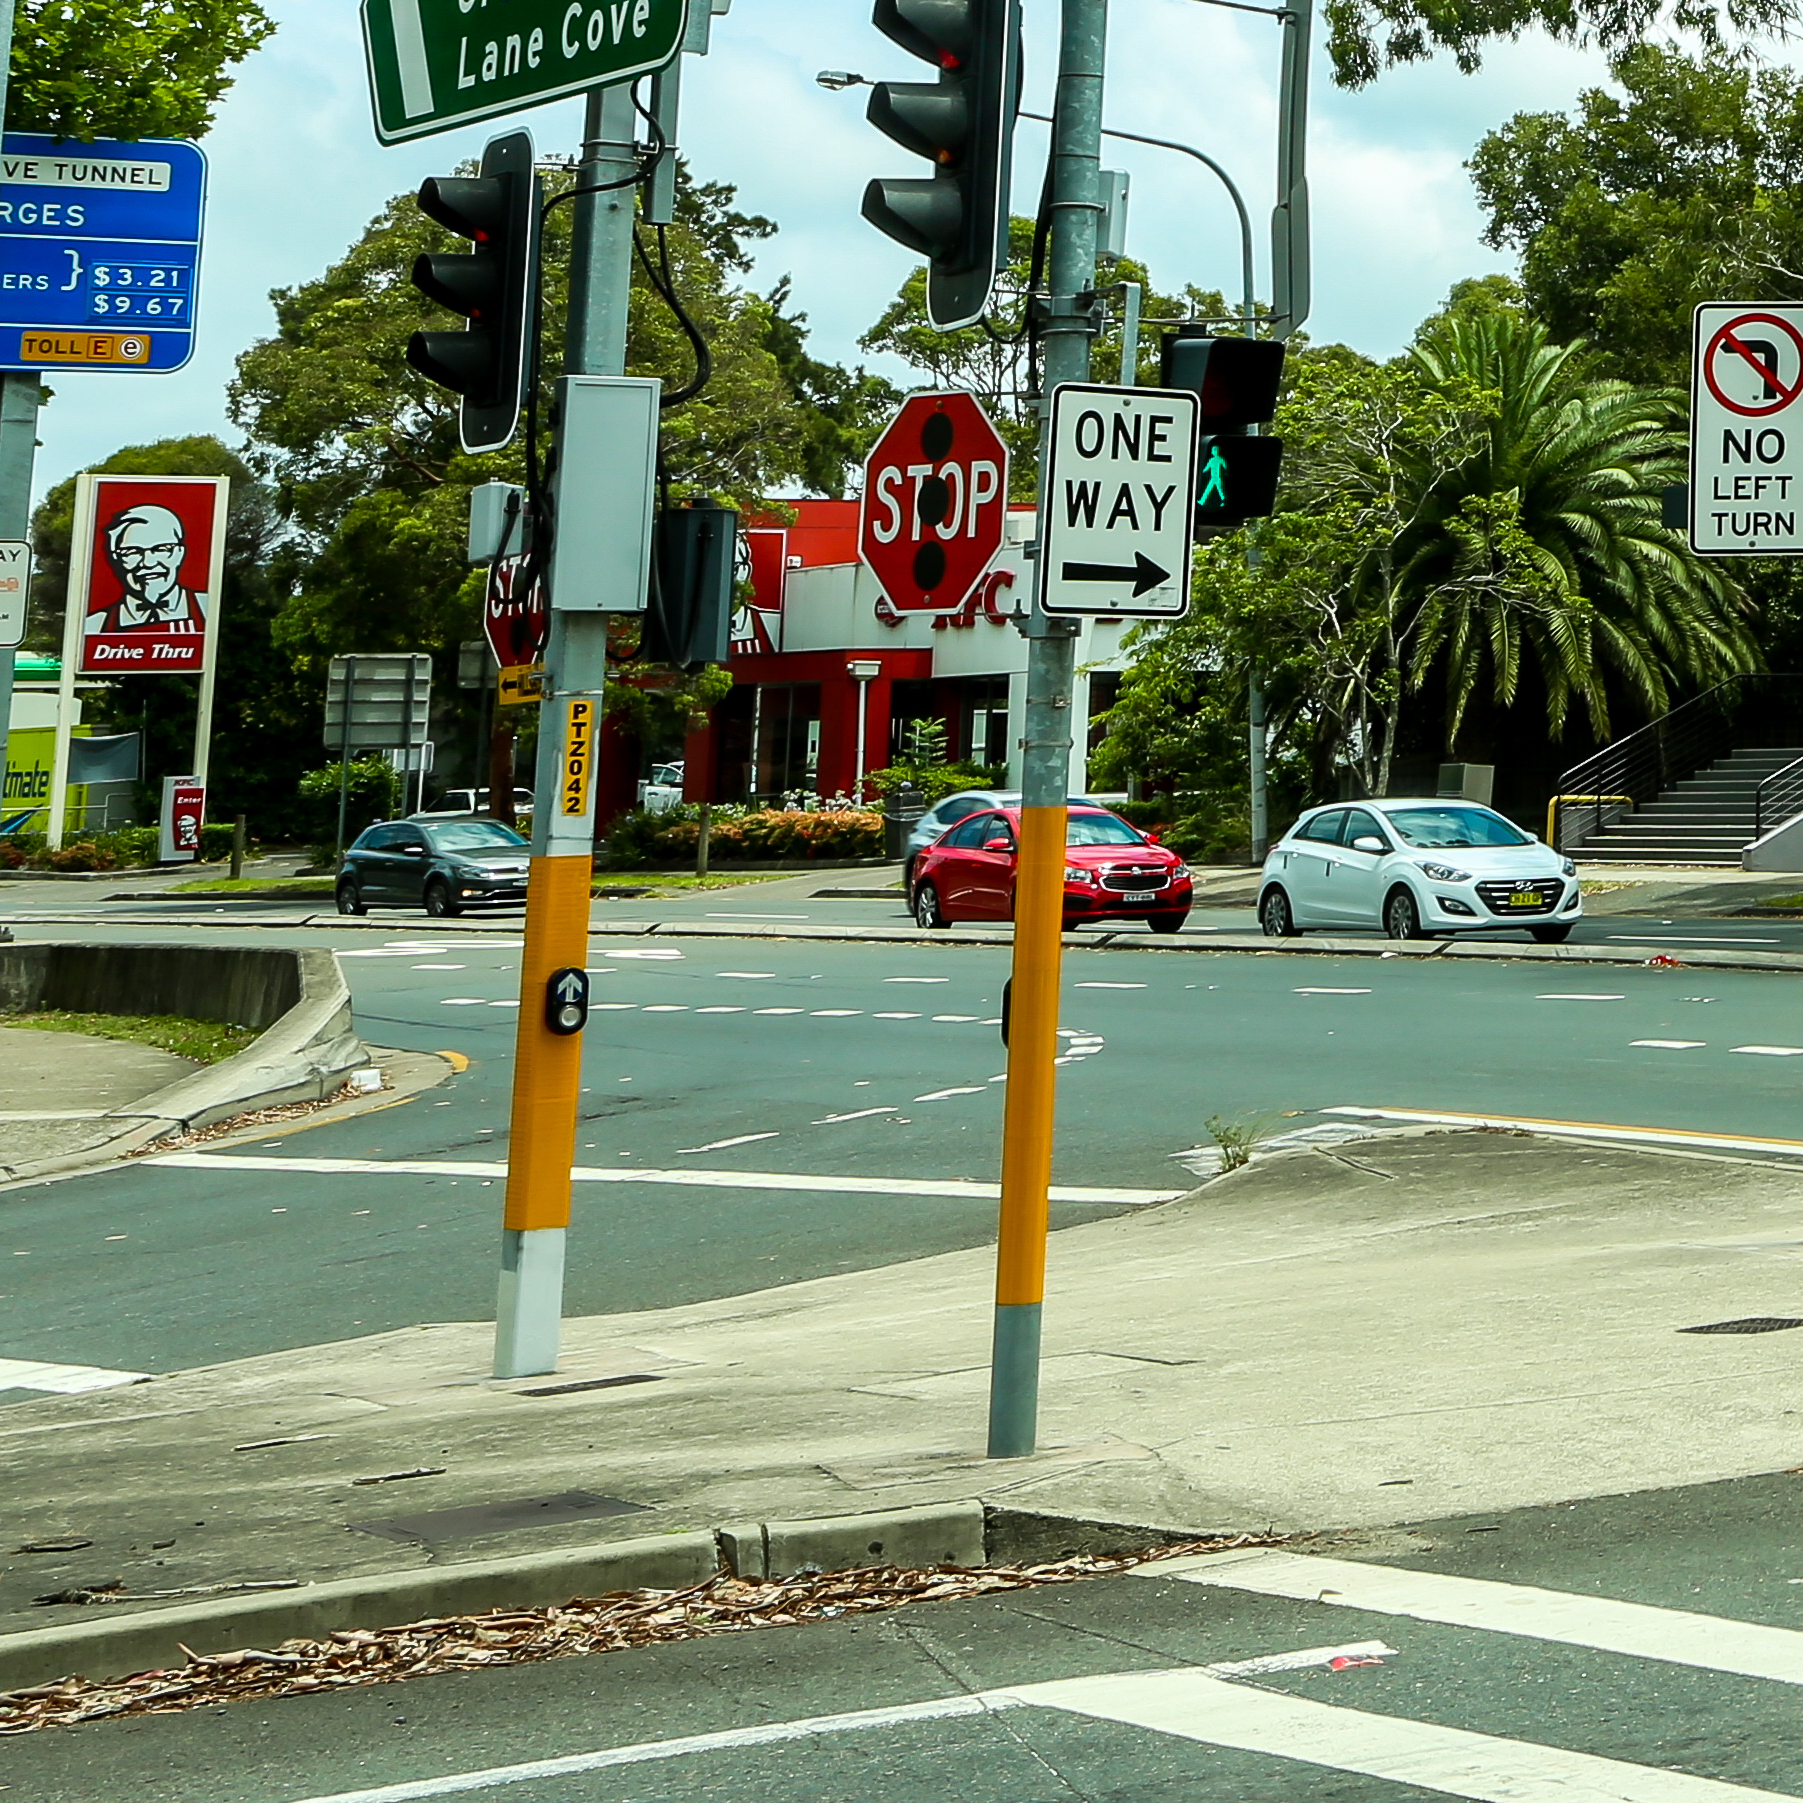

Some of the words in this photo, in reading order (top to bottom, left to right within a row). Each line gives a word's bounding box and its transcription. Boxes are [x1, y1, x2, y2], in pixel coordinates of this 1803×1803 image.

[458, 27, 543, 90] Lane
[4, 161, 39, 179] VE
[54, 163, 162, 185] TUNNEL
[3, 274, 49, 290] ERS
[94, 266, 179, 287] $3.21
[93, 294, 184, 315] $9.67
[25, 338, 82, 356] TOLL
[93, 339, 107, 356] E
[1076, 410, 1174, 463] ONE
[1722, 427, 1785, 464] NO
[1713, 476, 1793, 500] LEFT
[872, 460, 998, 544] STOP
[1065, 479, 1177, 532] WAY
[1711, 511, 1794, 536] TURN
[93, 644, 144, 659] Drive
[151, 643, 195, 659] Thru
[565, 703, 588, 814] PTZ042
[177, 796, 202, 804] Enter
